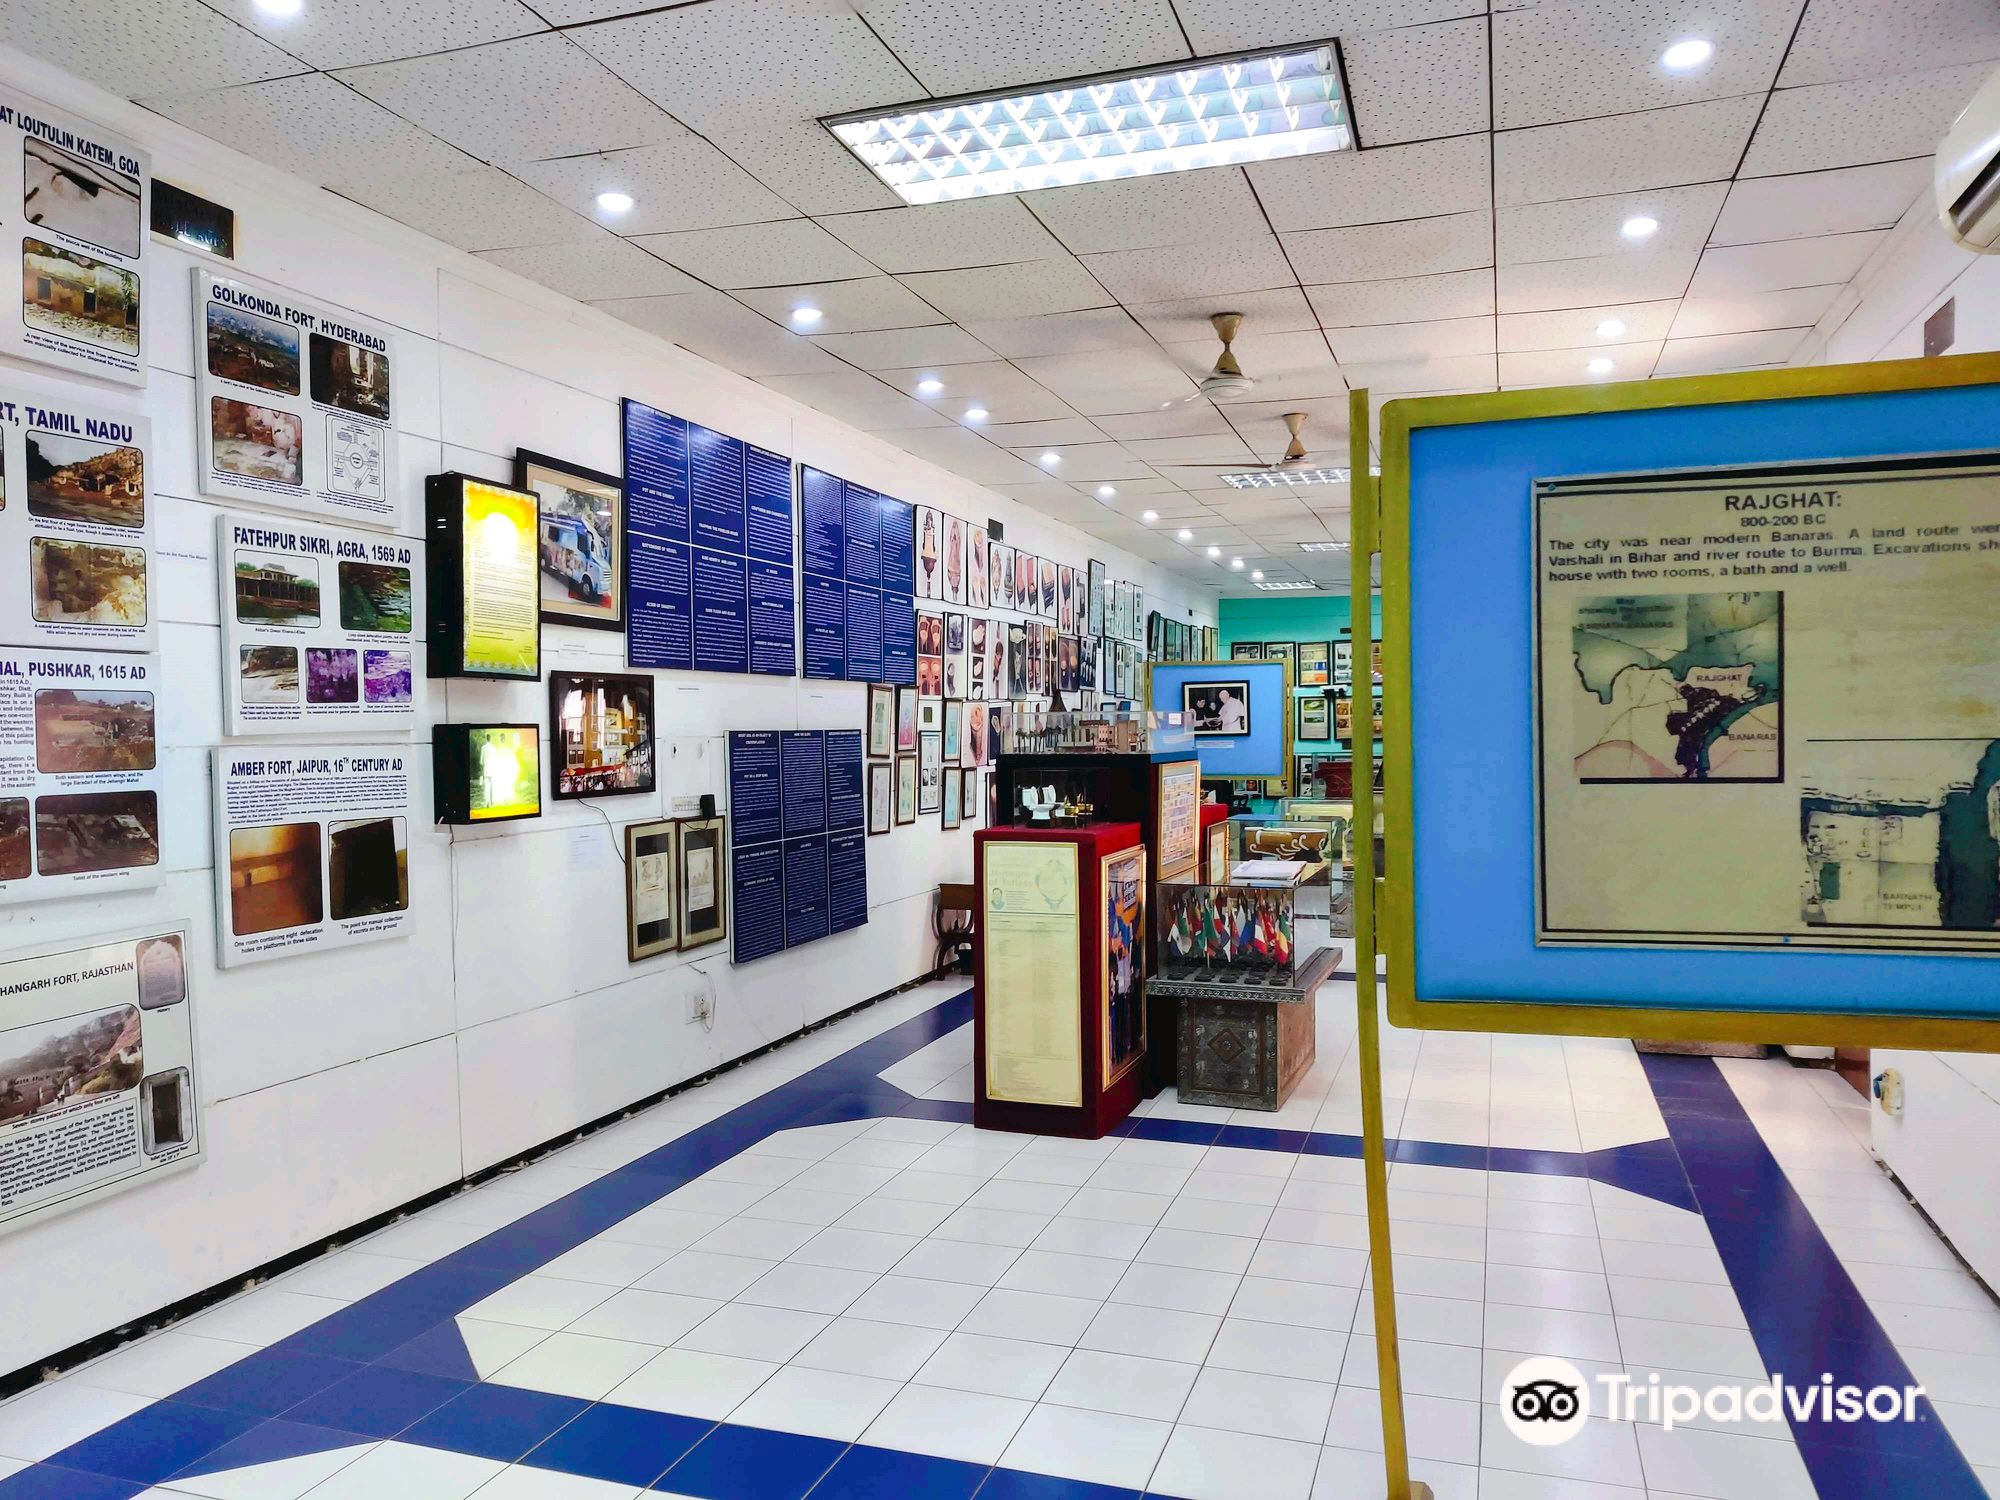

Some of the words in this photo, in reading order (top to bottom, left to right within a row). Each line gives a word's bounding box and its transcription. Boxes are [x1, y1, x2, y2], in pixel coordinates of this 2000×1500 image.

[0, 105, 14, 124] AT
[18, 113, 74, 150] LOUTULIN
[77, 138, 116, 170] KATEM,
[119, 156, 140, 177] GOA
[212, 284, 281, 318] GOLKONDA
[285, 307, 318, 332] FORT,
[321, 319, 386, 352] HYDERABAD
[25, 406, 80, 433] TAMIL
[86, 418, 132, 442] NADU
[1725, 491, 1841, 510] RAJGHAT:
[1740, 516, 1798, 527] 800-200
[1803, 514, 1826, 525] BC
[234, 526, 297, 551] FATEHPUR
[300, 535, 333, 558] SIKRI,
[336, 540, 369, 562] AGRA,
[372, 544, 395, 562] 1569
[398, 549, 411, 564] AD
[1550, 540, 1574, 550] The
[1584, 538, 1609, 551] city
[1620, 538, 1648, 547] was
[1660, 537, 1691, 546] near
[1703, 533, 1760, 544] modern
[1849, 528, 1859, 539] A
[1872, 527, 1905, 538] land
[1916, 525, 1959, 536] route
[1610, 556, 1621, 564] in
[1628, 552, 1667, 563] Bihar
[1673, 550, 1700, 562] and
[1707, 551, 1739, 560] river
[1747, 548, 1785, 559] route
[1792, 547, 1806, 557] to
[1874, 542, 1970, 555] Excavations
[1549, 571, 1592, 581] house
[1596, 569, 1627, 580] with
[1632, 569, 1658, 579] two
[1663, 568, 1715, 578] rooms,
[1719, 568, 1728, 576] a
[1733, 564, 1766, 575] bath
[1771, 563, 1799, 574] and
[1804, 565, 1812, 573] a
[1817, 561, 1851, 572] well.
[0, 661, 24, 678] AL,
[29, 662, 95, 680] PUSHKAR,
[99, 665, 126, 679] 1615
[130, 666, 146, 680] AD
[230, 762, 265, 776] AMBER
[268, 760, 295, 776] FORT,
[296, 759, 332, 775] JAIPUR,
[352, 758, 389, 772] CENTURY
[392, 758, 403, 771] AD
[0, 979, 50, 996] HANGARH
[53, 973, 80, 986] FORT,
[82, 962, 134, 980] RAJASTHAN
